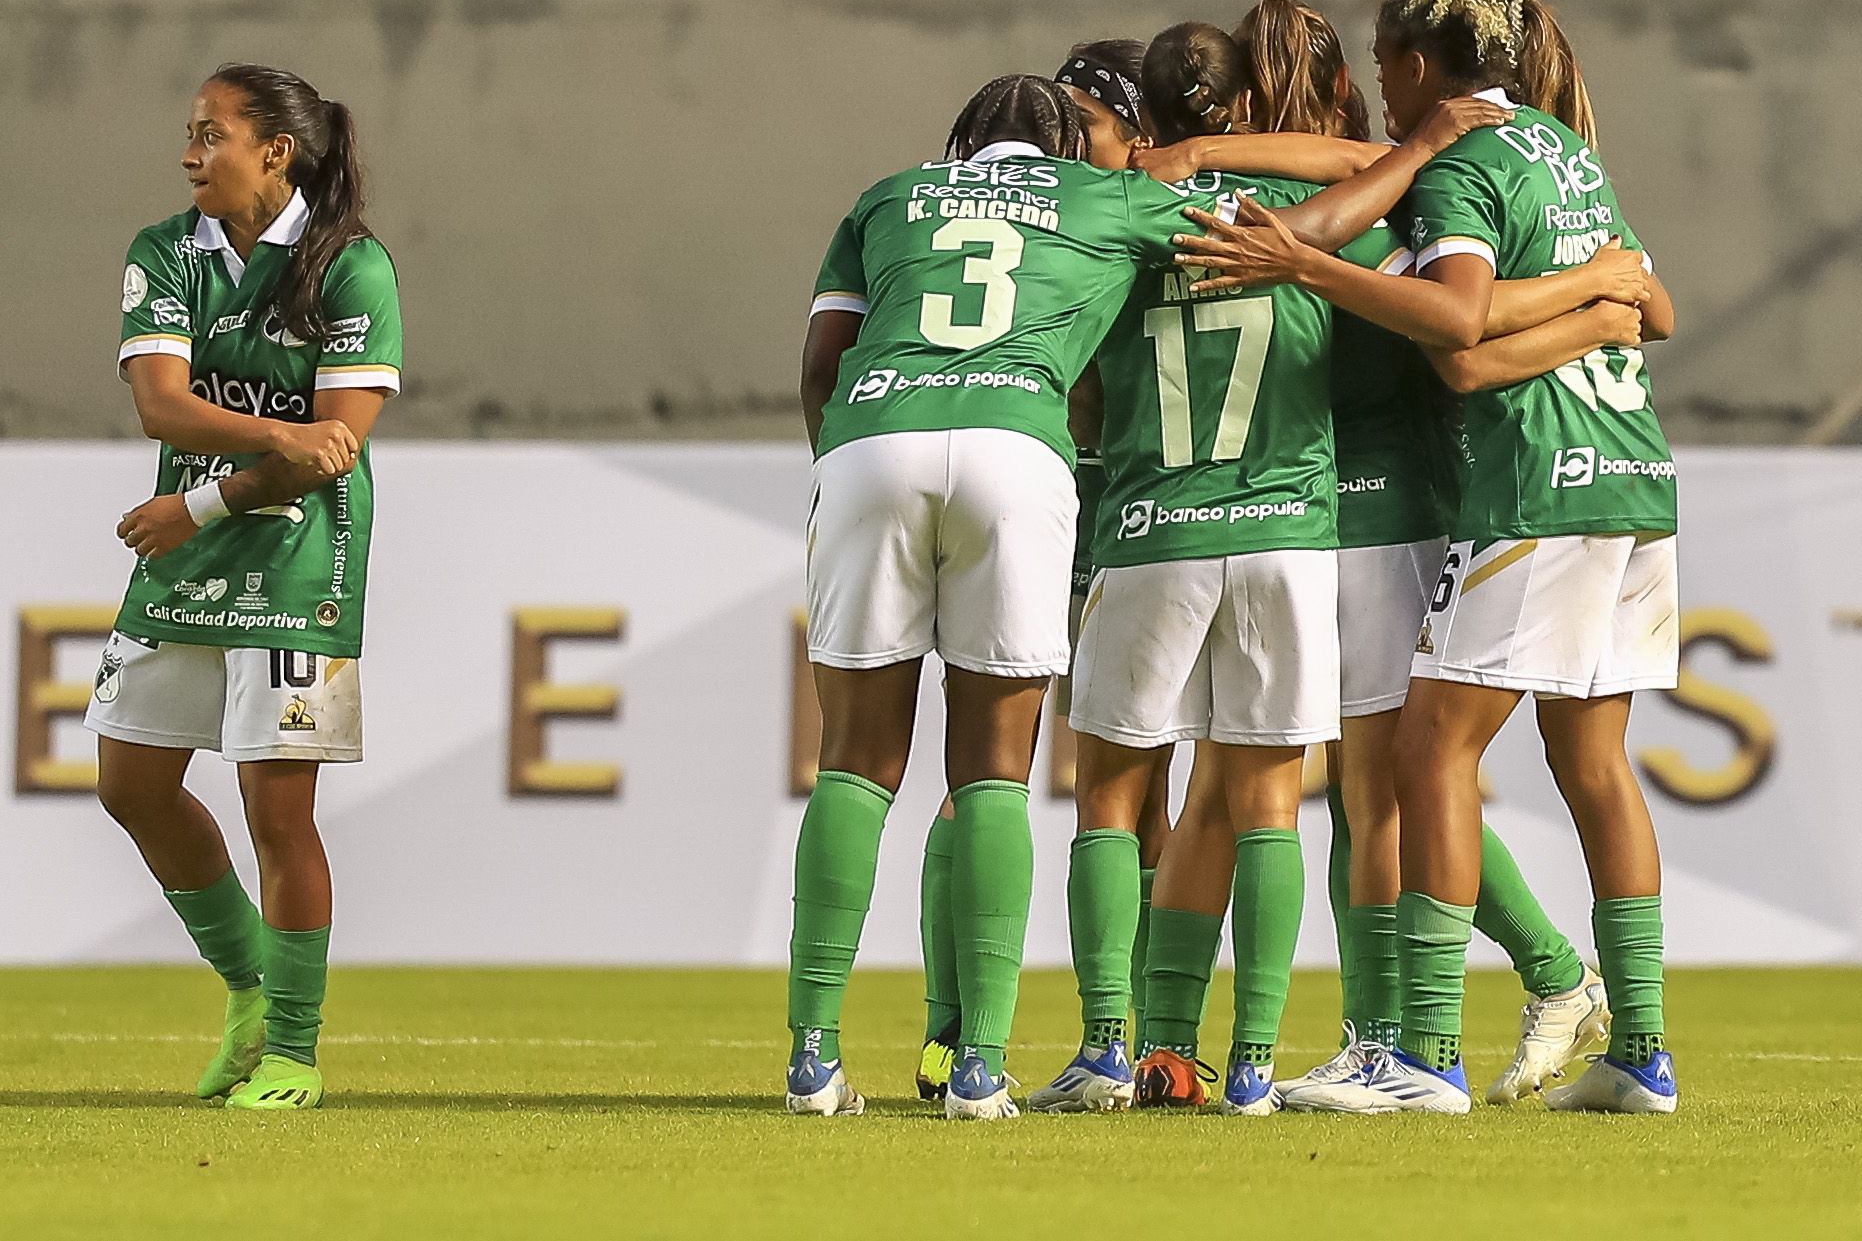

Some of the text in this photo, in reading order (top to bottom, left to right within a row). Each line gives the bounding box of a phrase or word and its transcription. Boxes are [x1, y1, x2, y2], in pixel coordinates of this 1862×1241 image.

[907, 200, 933, 223] K.
[920, 217, 1025, 351] 3
[963, 371, 1041, 394] popular
[1144, 296, 1275, 468] 17
[172, 454, 207, 467] PASTAS
[208, 455, 234, 477] La
[1155, 500, 1308, 525] banco popular
[145, 603, 170, 621] Cali
[171, 608, 227, 627] Ciudad
[227, 611, 308, 631] Deportiva
[269, 649, 317, 689] 10
